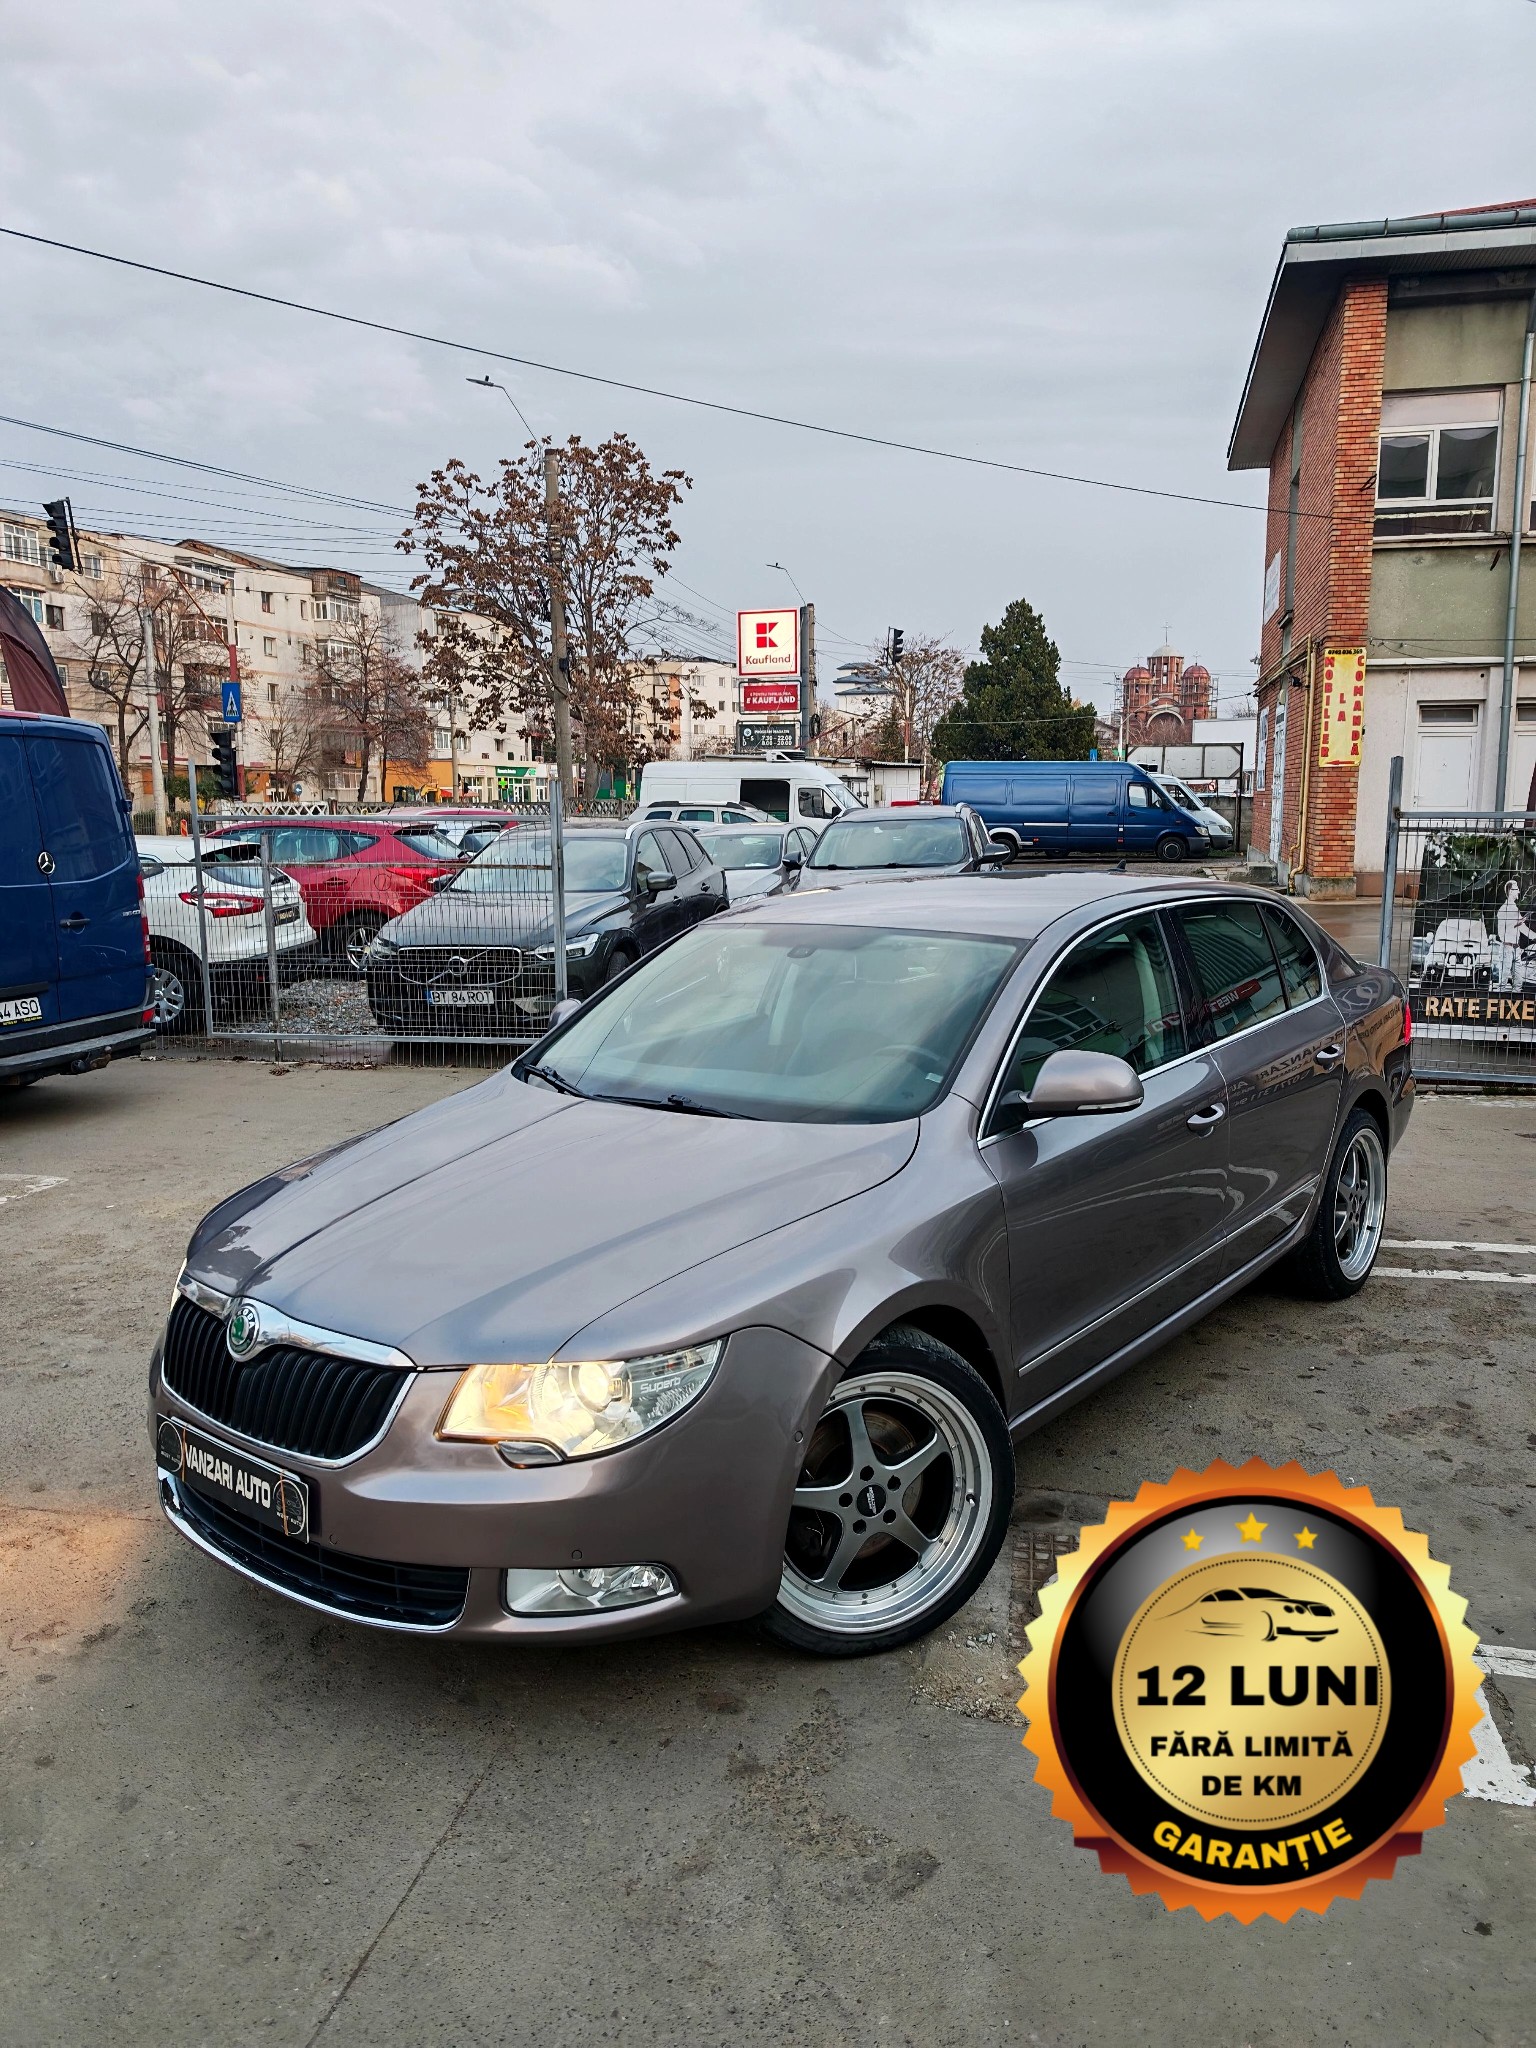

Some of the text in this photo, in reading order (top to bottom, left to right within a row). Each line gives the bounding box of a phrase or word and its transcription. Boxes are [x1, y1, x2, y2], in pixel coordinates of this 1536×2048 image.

[745, 654, 791, 665] Kaufland
[752, 696, 796, 705] KAUFLAND
[1321, 657, 1335, 757] MOBILIER
[1337, 693, 1346, 722] LA
[432, 991, 490, 1003] BT 84 ROT
[15, 1000, 39, 1017] ASO
[1425, 995, 1535, 1021] RATE FIXE
[640, 1376, 681, 1394] Superb
[185, 1442, 271, 1509] VANZARI AUTO
